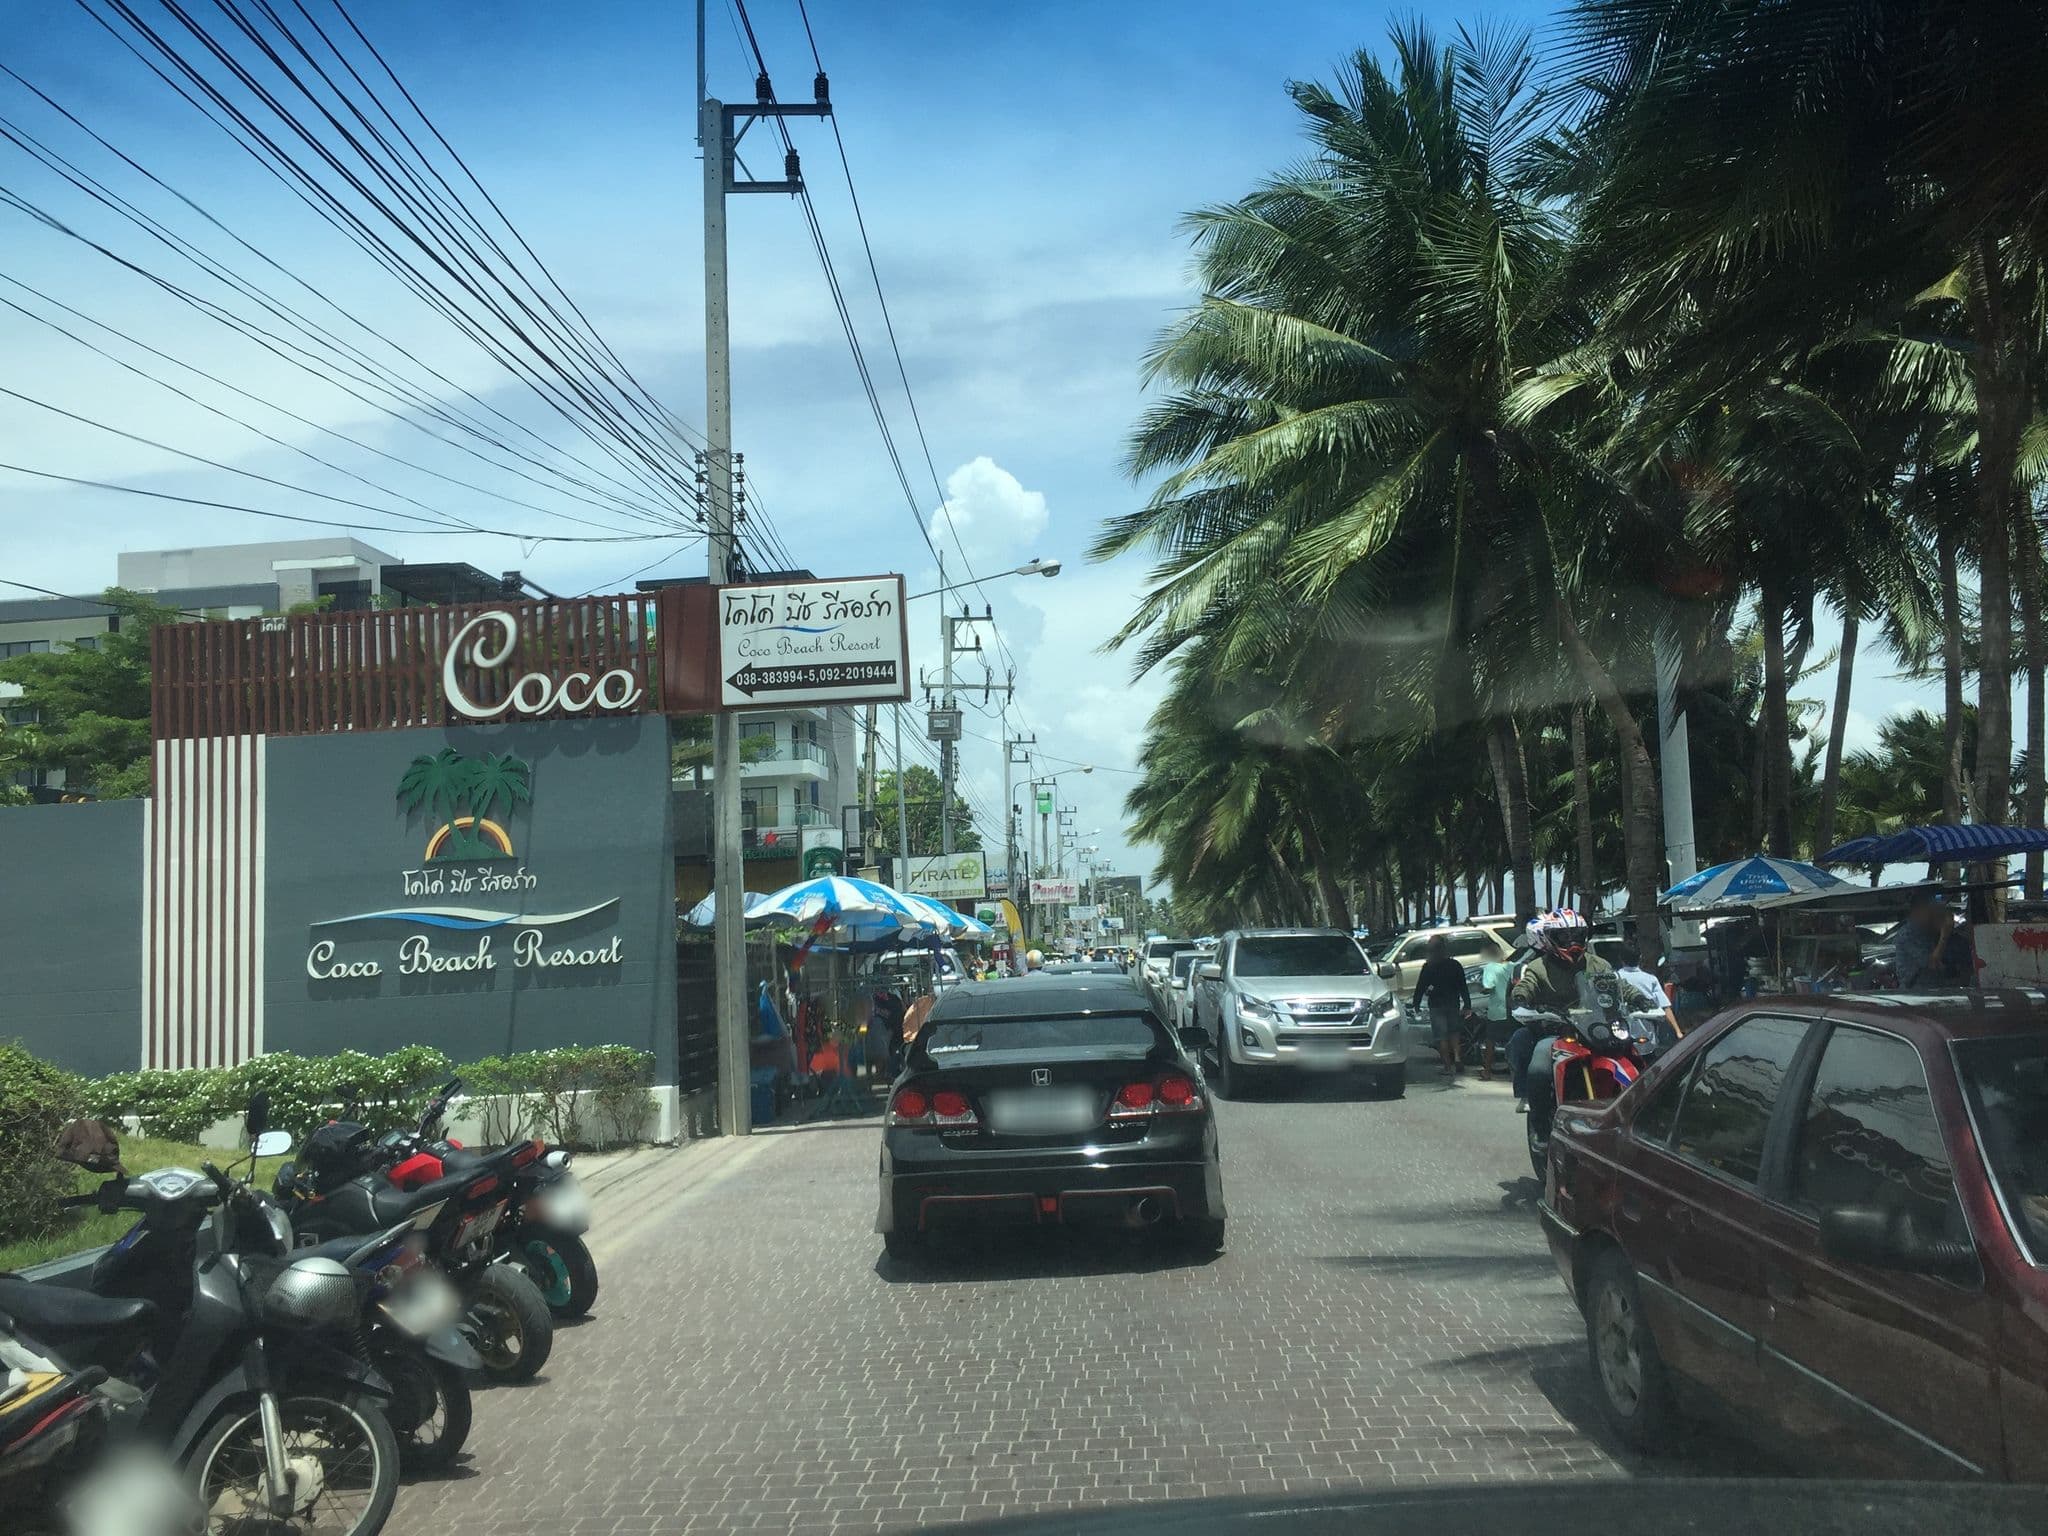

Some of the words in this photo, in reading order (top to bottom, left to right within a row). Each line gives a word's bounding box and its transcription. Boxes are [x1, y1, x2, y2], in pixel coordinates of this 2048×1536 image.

[725, 595, 775, 626] โคโค่
[786, 592, 819, 622] บีช
[822, 589, 892, 621] รีสอร์ท
[737, 638, 771, 658] Coco
[777, 636, 823, 656] Beach
[830, 632, 881, 652] Resort
[444, 610, 642, 718] Coco
[736, 664, 895, 687] 038-383994-5,092-2019444
[402, 868, 445, 897] โคโค่
[450, 869, 478, 895] บีช
[479, 866, 538, 892] รีสอร์ท
[911, 868, 973, 883] PIRATE
[307, 940, 382, 979] Coco
[400, 935, 497, 975] Beach
[513, 929, 624, 968] Resort
